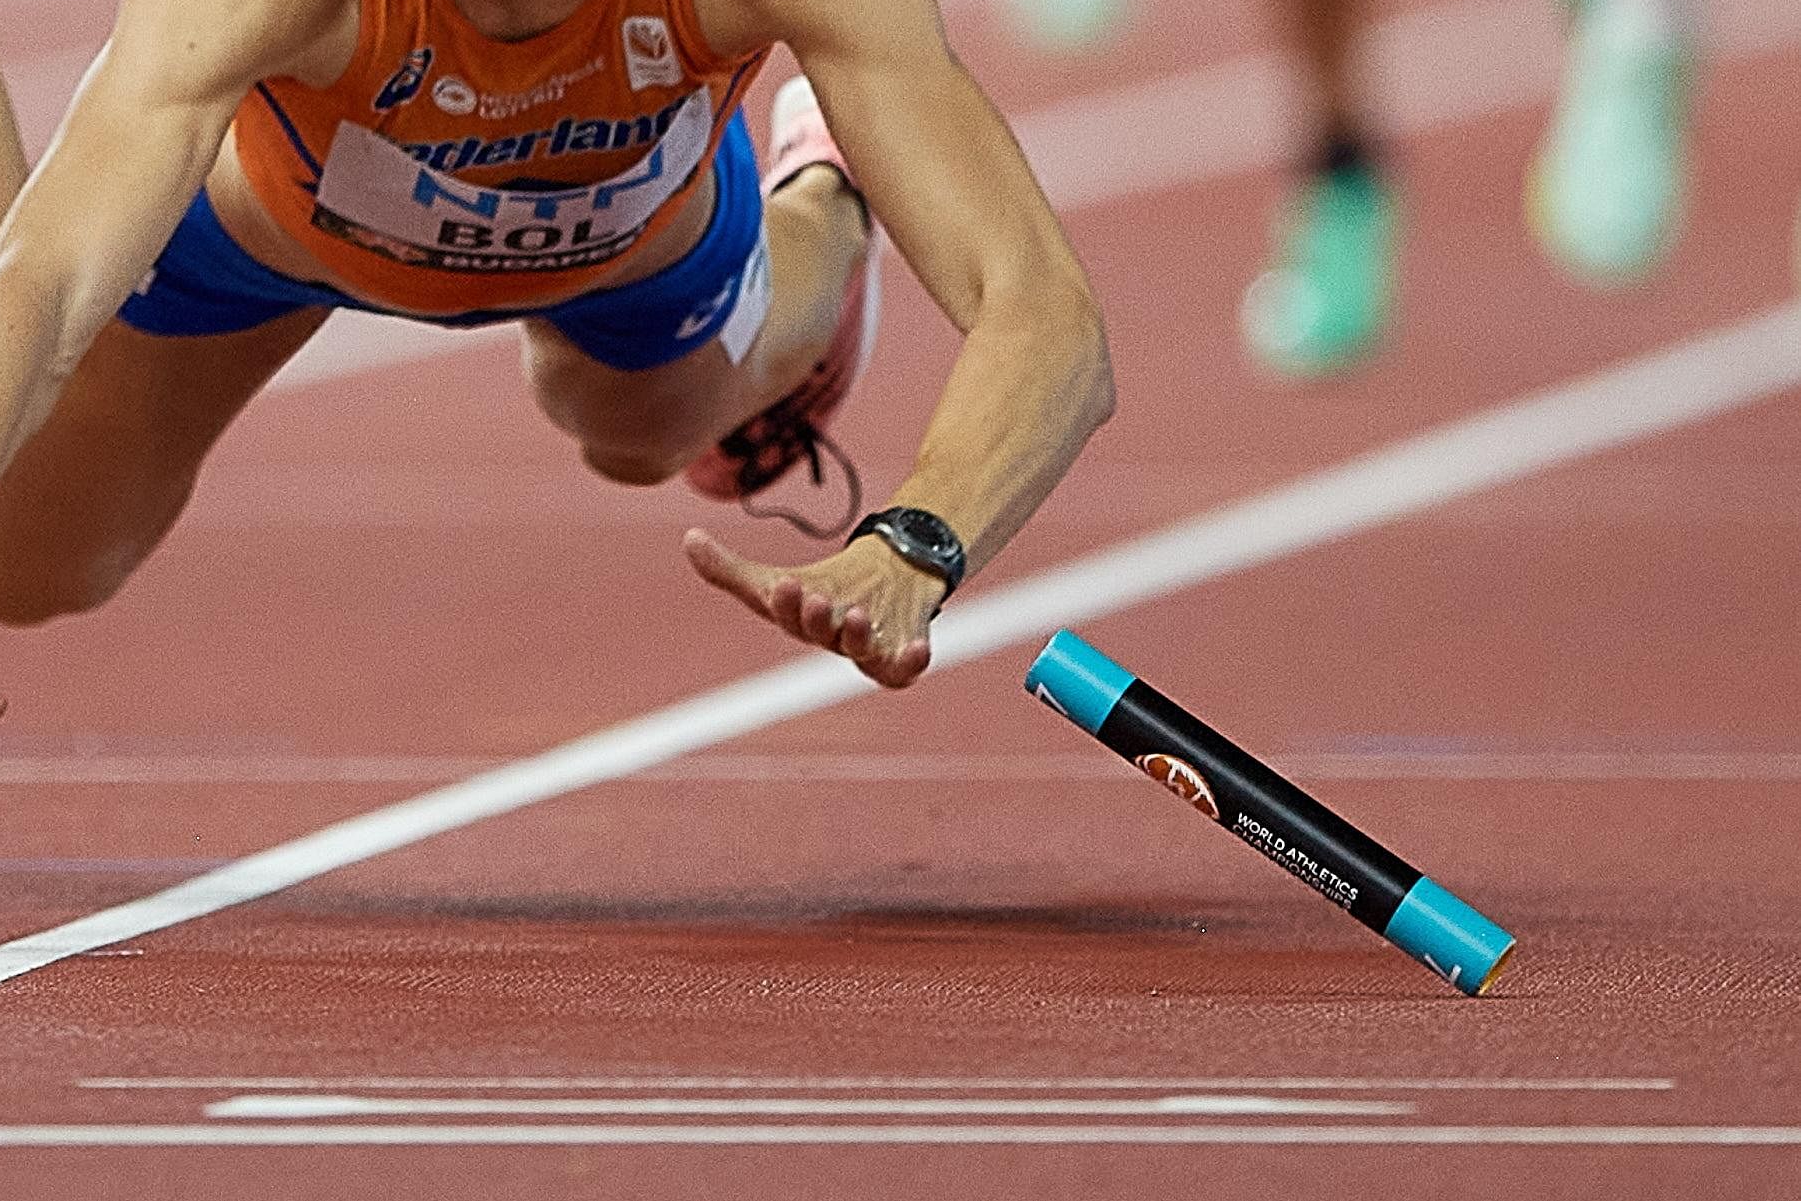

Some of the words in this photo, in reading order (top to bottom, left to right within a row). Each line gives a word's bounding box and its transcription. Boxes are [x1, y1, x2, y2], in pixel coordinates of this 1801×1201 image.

[437, 219, 617, 251] BOL
[1232, 824, 1352, 910] CHAMPIONSHIPS
[1237, 812, 1286, 851] WORLD
[1286, 848, 1359, 901] ATHLETICS
